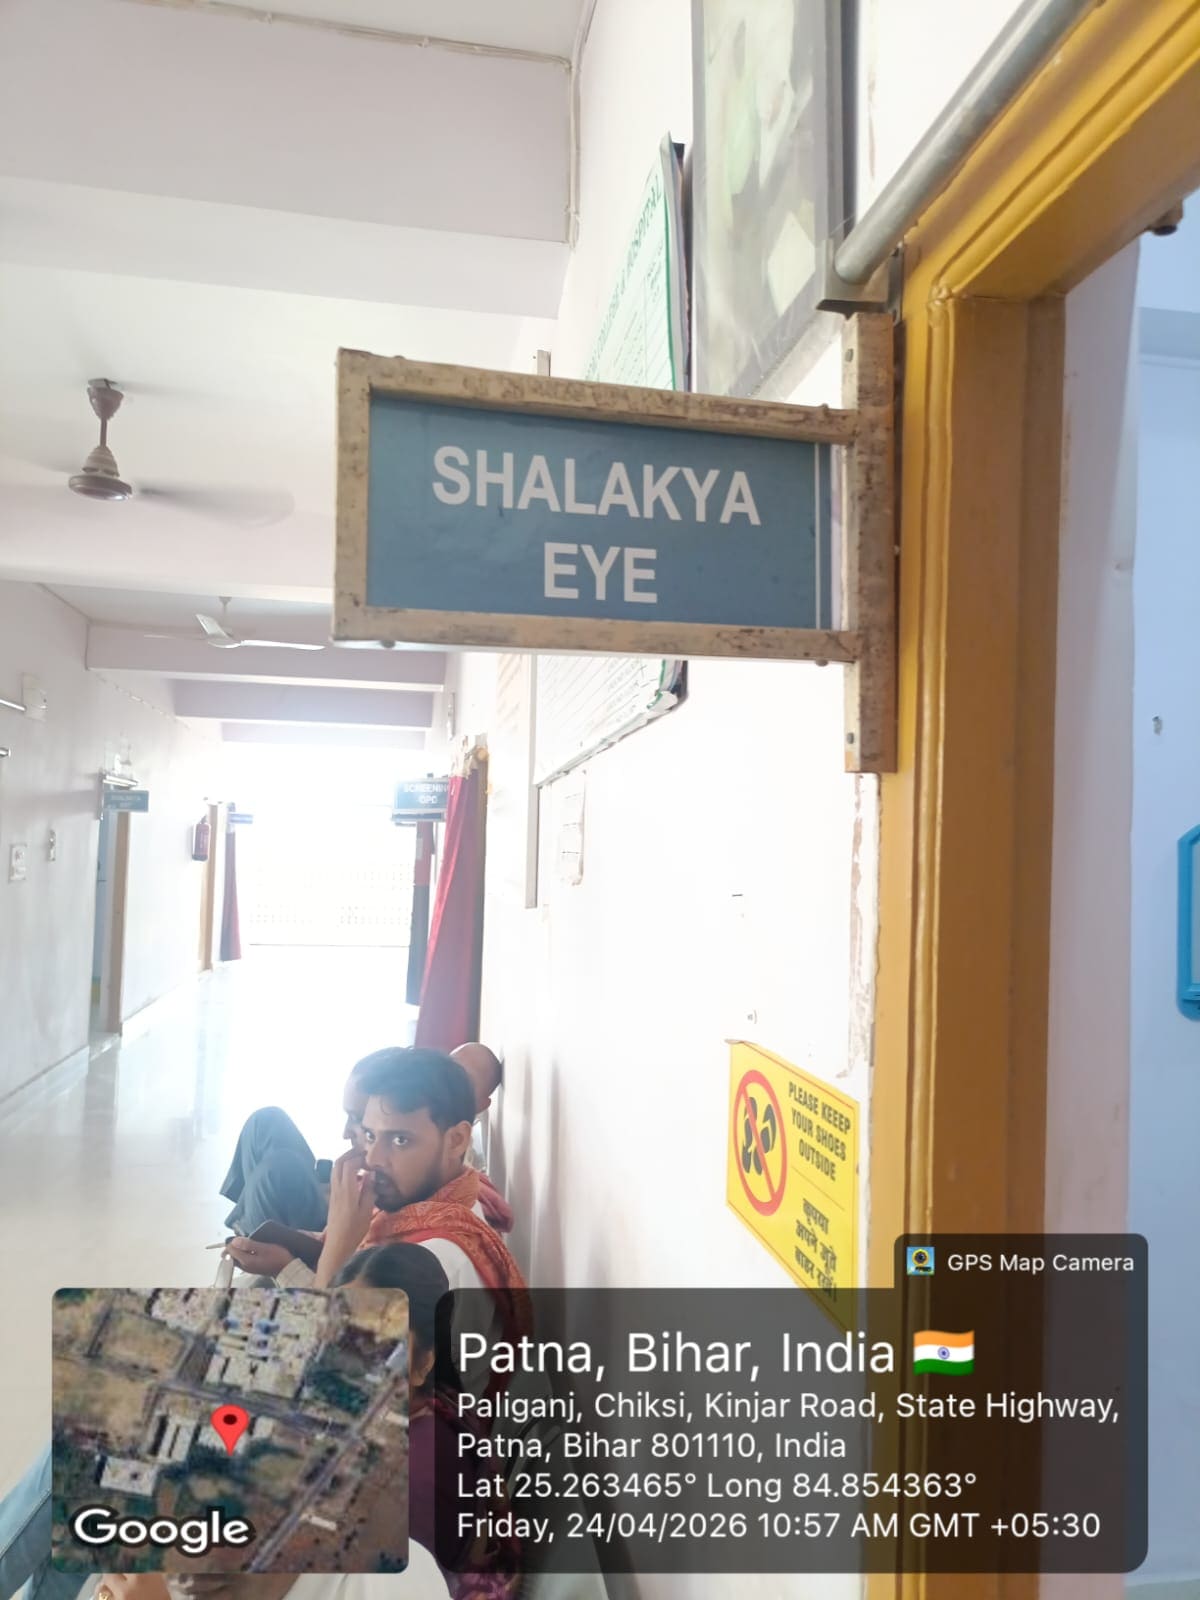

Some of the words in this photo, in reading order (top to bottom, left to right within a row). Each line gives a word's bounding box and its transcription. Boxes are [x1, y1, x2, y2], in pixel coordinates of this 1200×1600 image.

[432, 445, 761, 526] SHALAKYA
[544, 542, 658, 604] EYE
[788, 1081, 819, 1115] PLEASE
[821, 1101, 851, 1135] KEEEP
[791, 1106, 813, 1138] YOUR
[815, 1124, 846, 1161] SHOES
[799, 1138, 836, 1182] OUTSIDE
[803, 1197, 829, 1235] कृपया
[795, 1245, 814, 1279] बाहर
[796, 1219, 818, 1253] अपने
[819, 1241, 837, 1274] जूते
